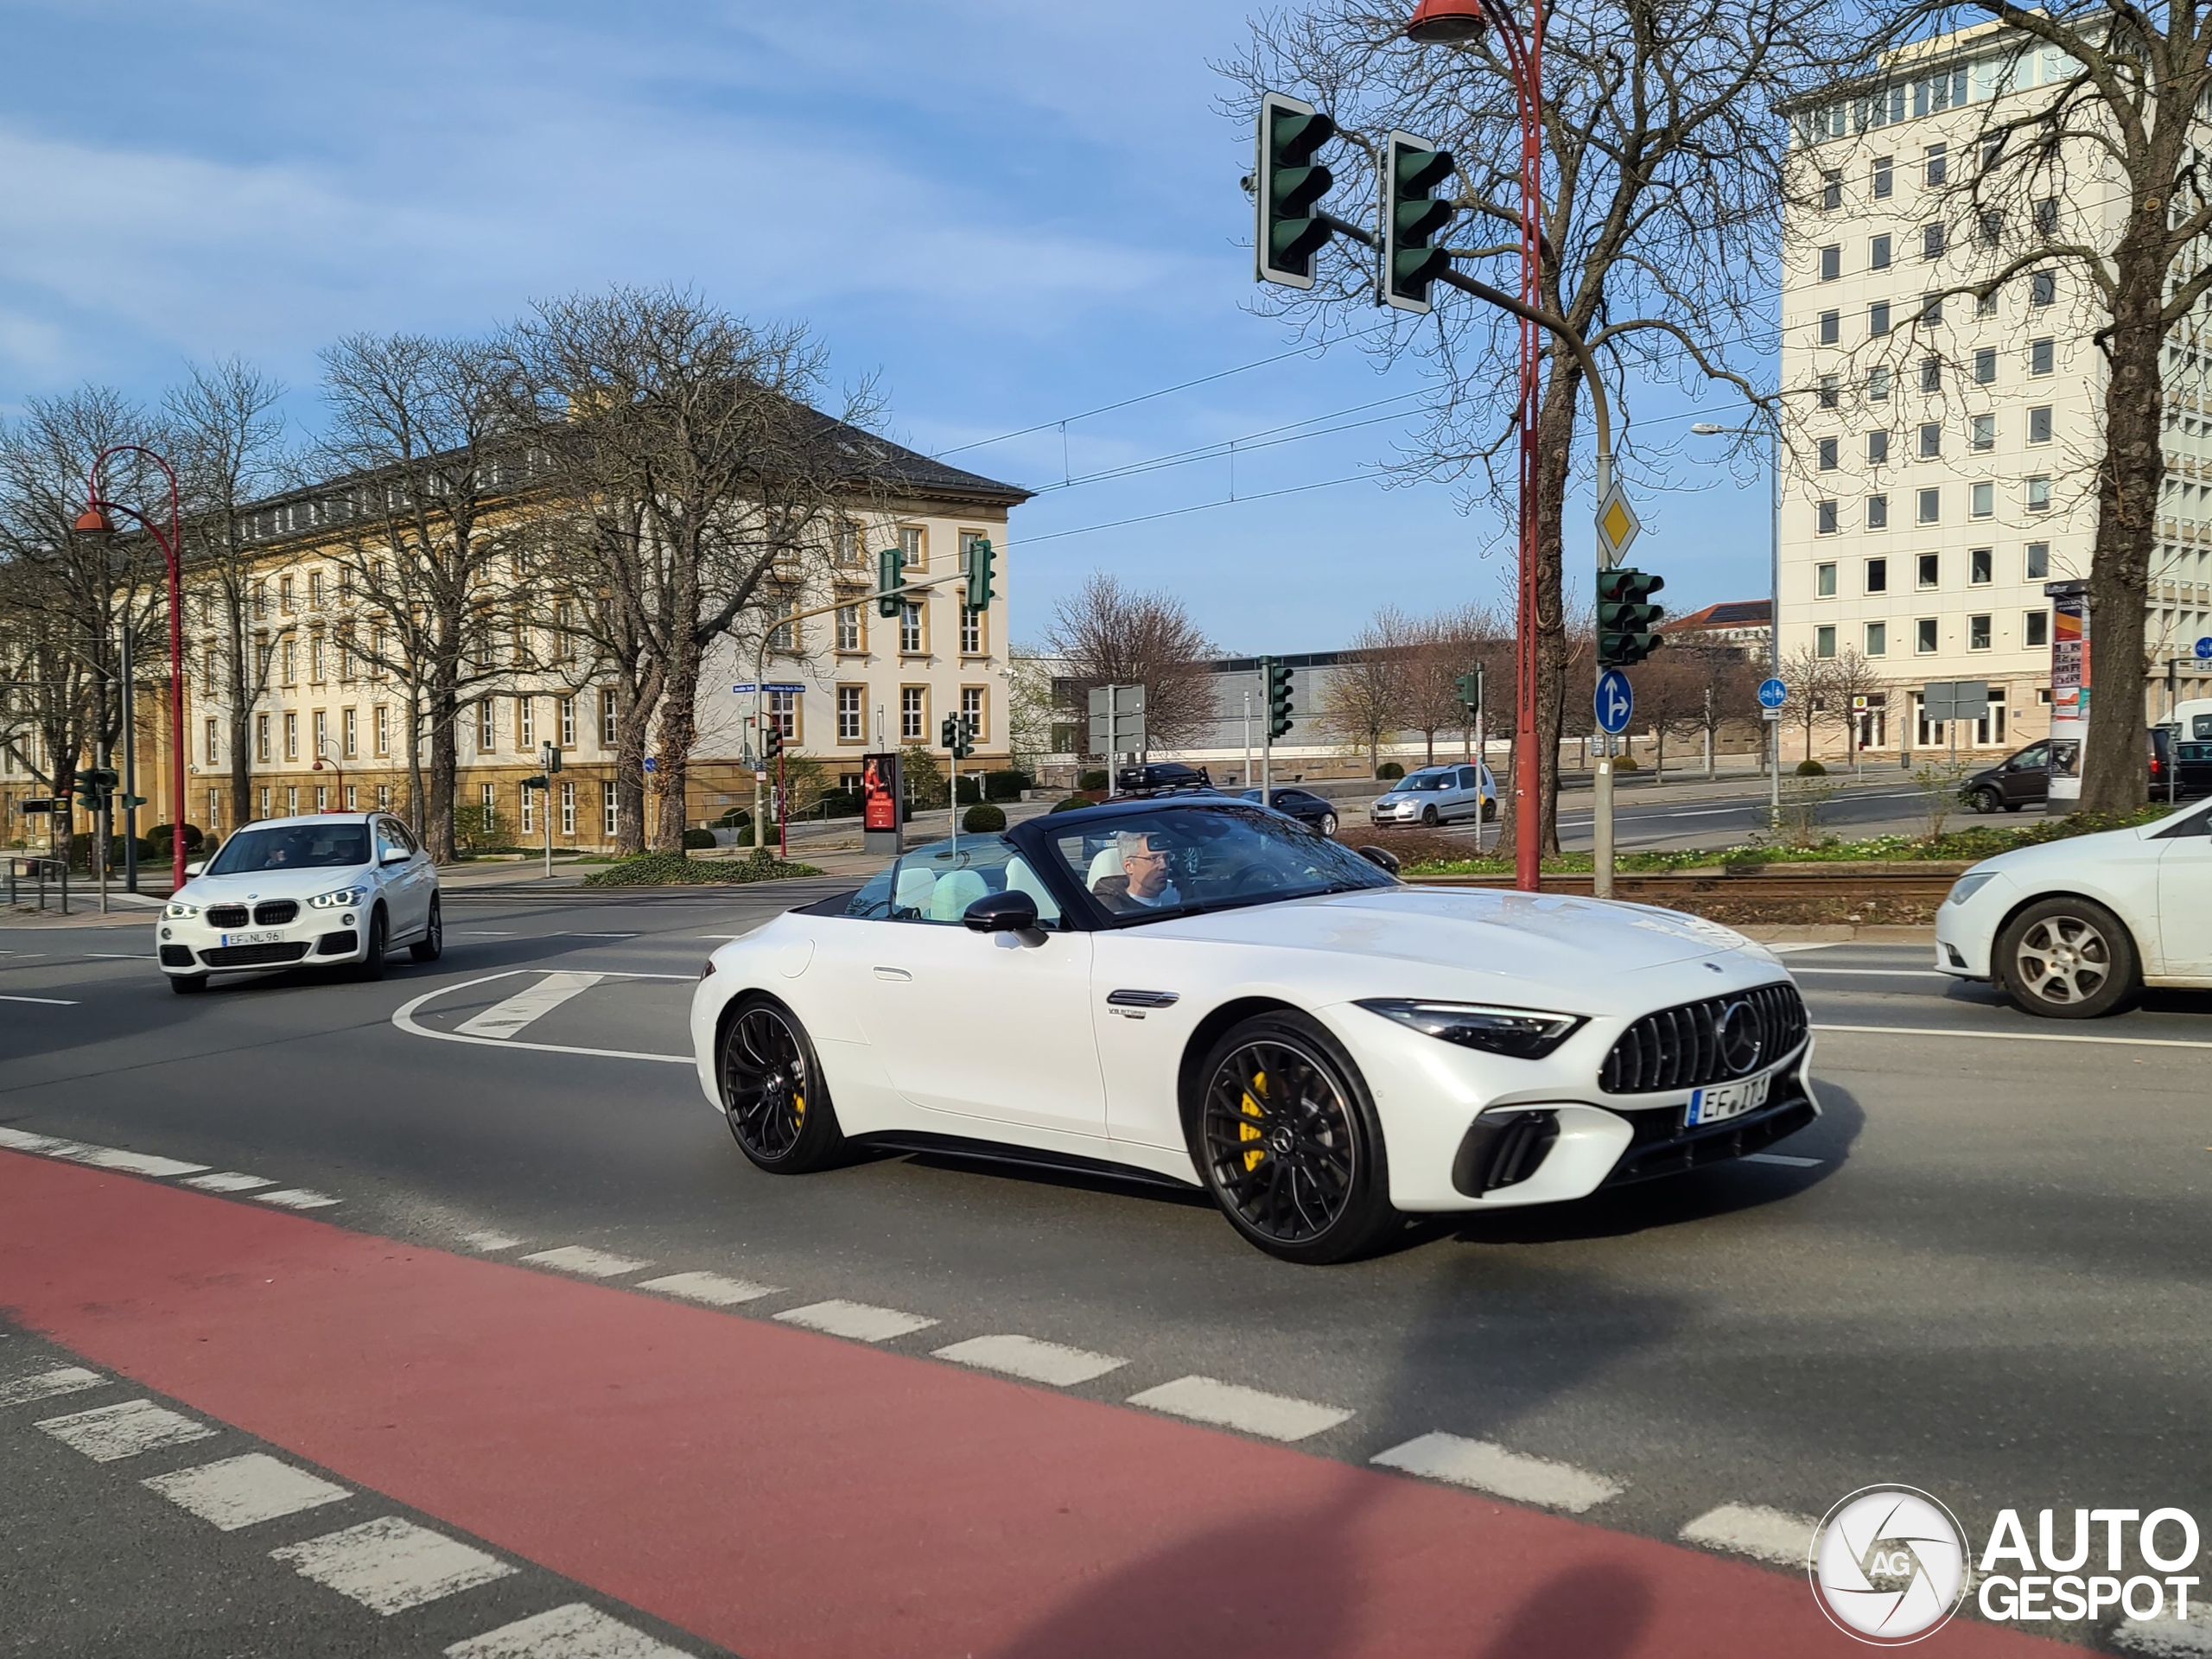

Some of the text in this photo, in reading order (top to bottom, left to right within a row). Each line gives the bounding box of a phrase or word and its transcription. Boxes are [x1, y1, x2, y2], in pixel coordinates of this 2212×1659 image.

[230, 932, 279, 944] EF NL 96
[1704, 1090, 1731, 1118] EF
